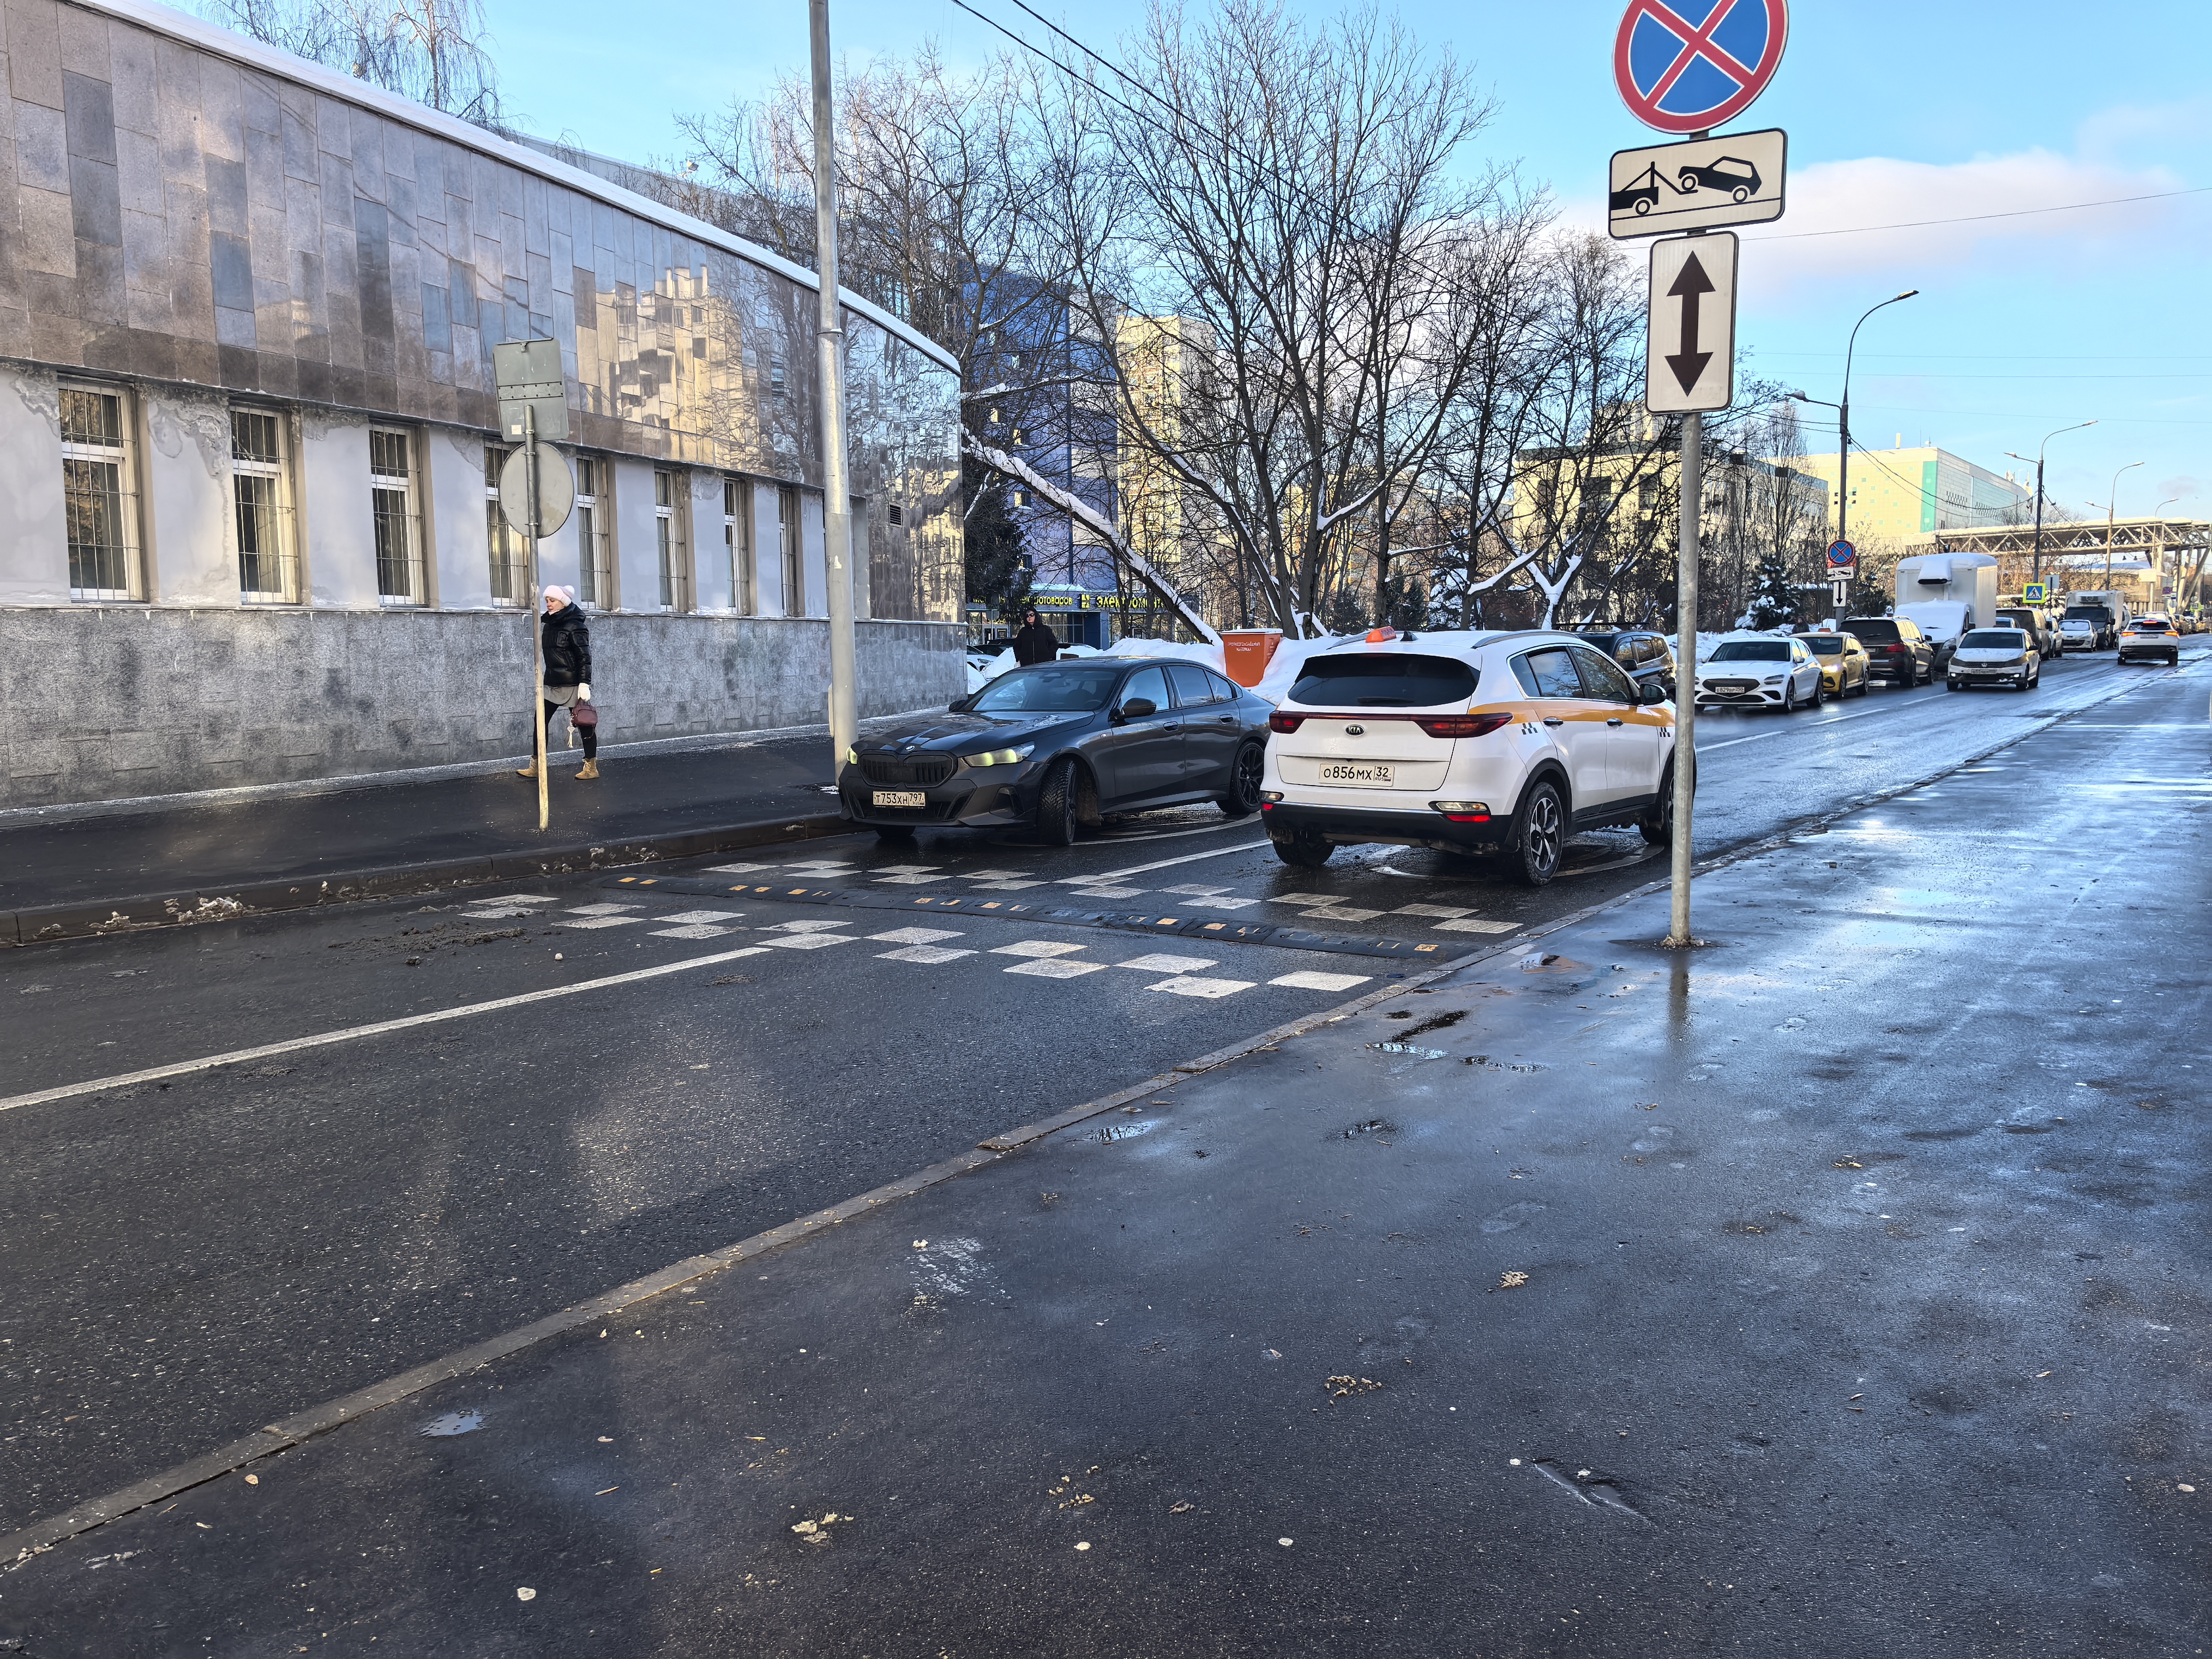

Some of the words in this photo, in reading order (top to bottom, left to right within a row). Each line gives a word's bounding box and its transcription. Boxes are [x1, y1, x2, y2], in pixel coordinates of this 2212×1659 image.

[1324, 766, 1372, 780] О856МХ
[1376, 767, 1388, 777] 32
[876, 793, 908, 804] Т753ХН
[909, 793, 922, 802] 797
